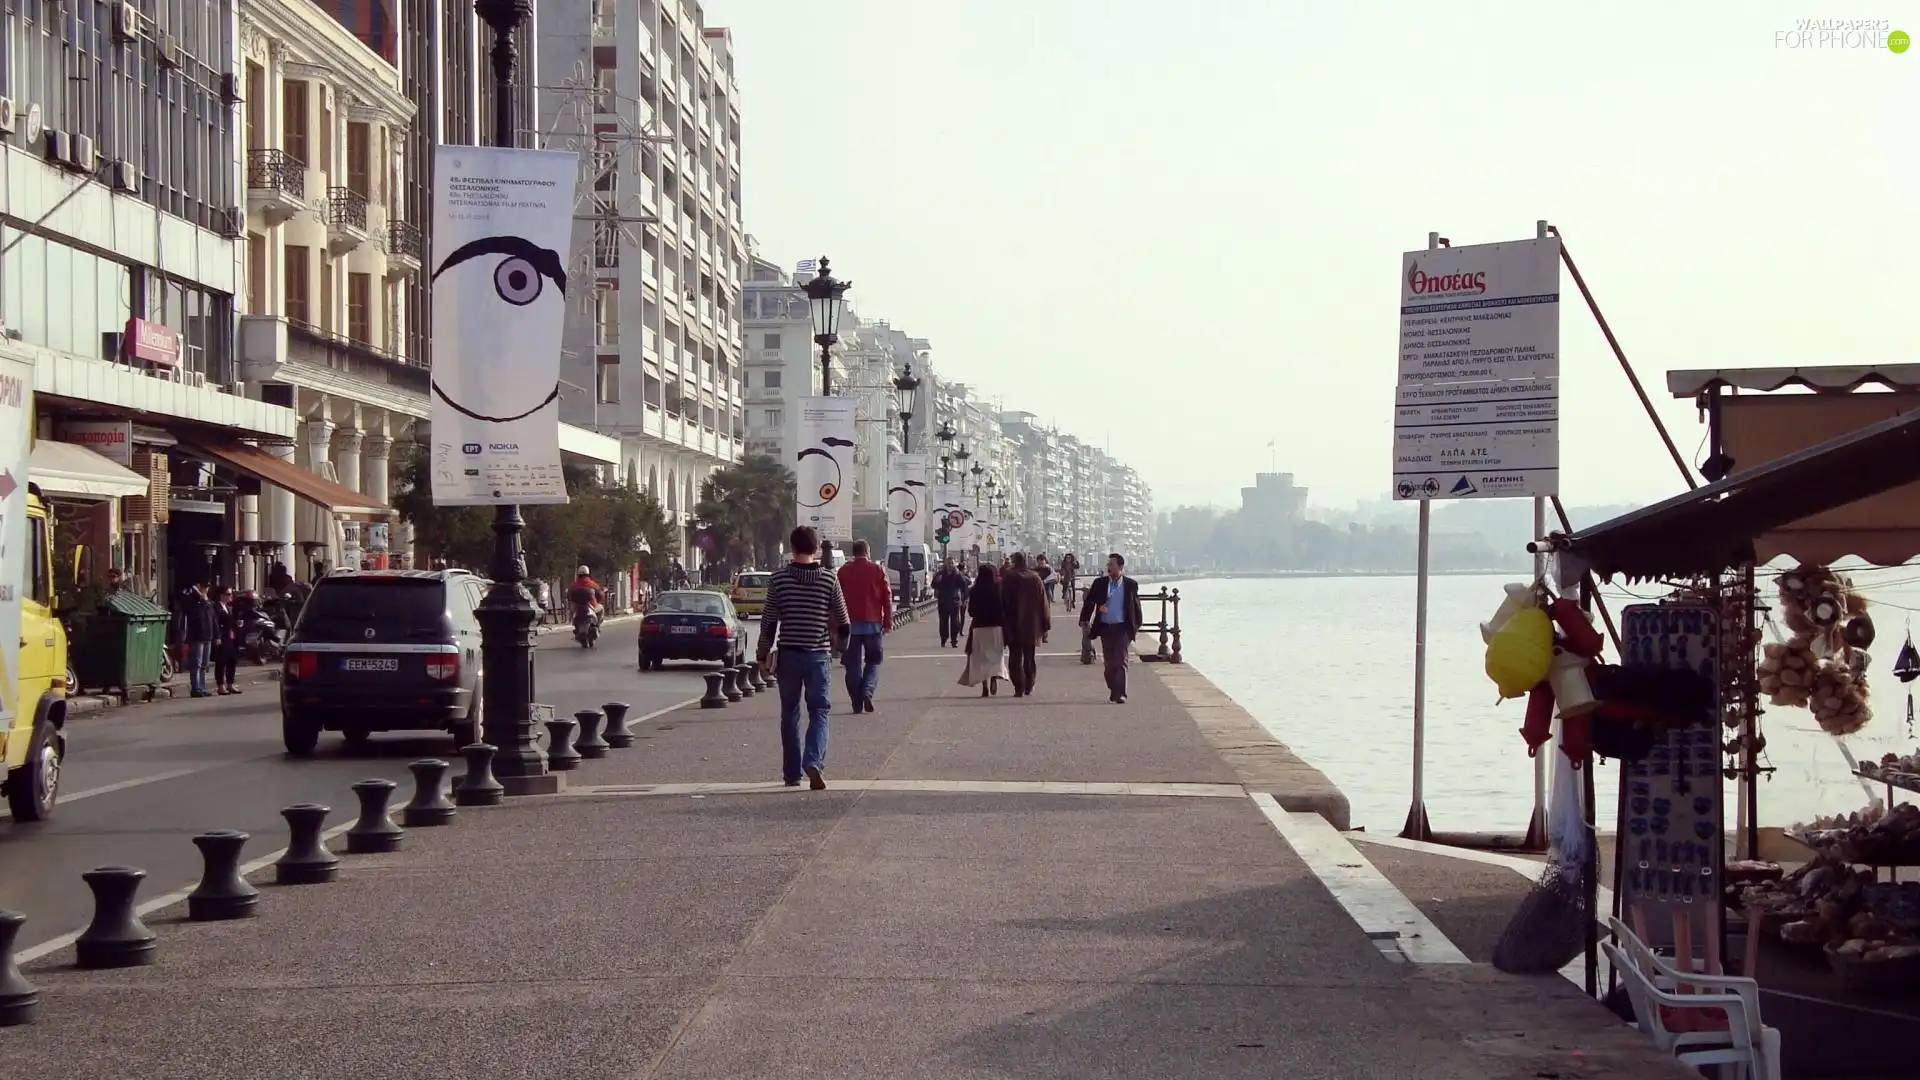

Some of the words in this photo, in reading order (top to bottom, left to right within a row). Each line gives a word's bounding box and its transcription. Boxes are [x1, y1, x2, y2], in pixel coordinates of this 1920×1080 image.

[449, 200, 500, 208] INTERNATIONAL
[1411, 268, 1487, 296] Θησέας
[488, 443, 520, 451] NOKIA
[1440, 448, 1466, 457] ΑΛΠΑ
